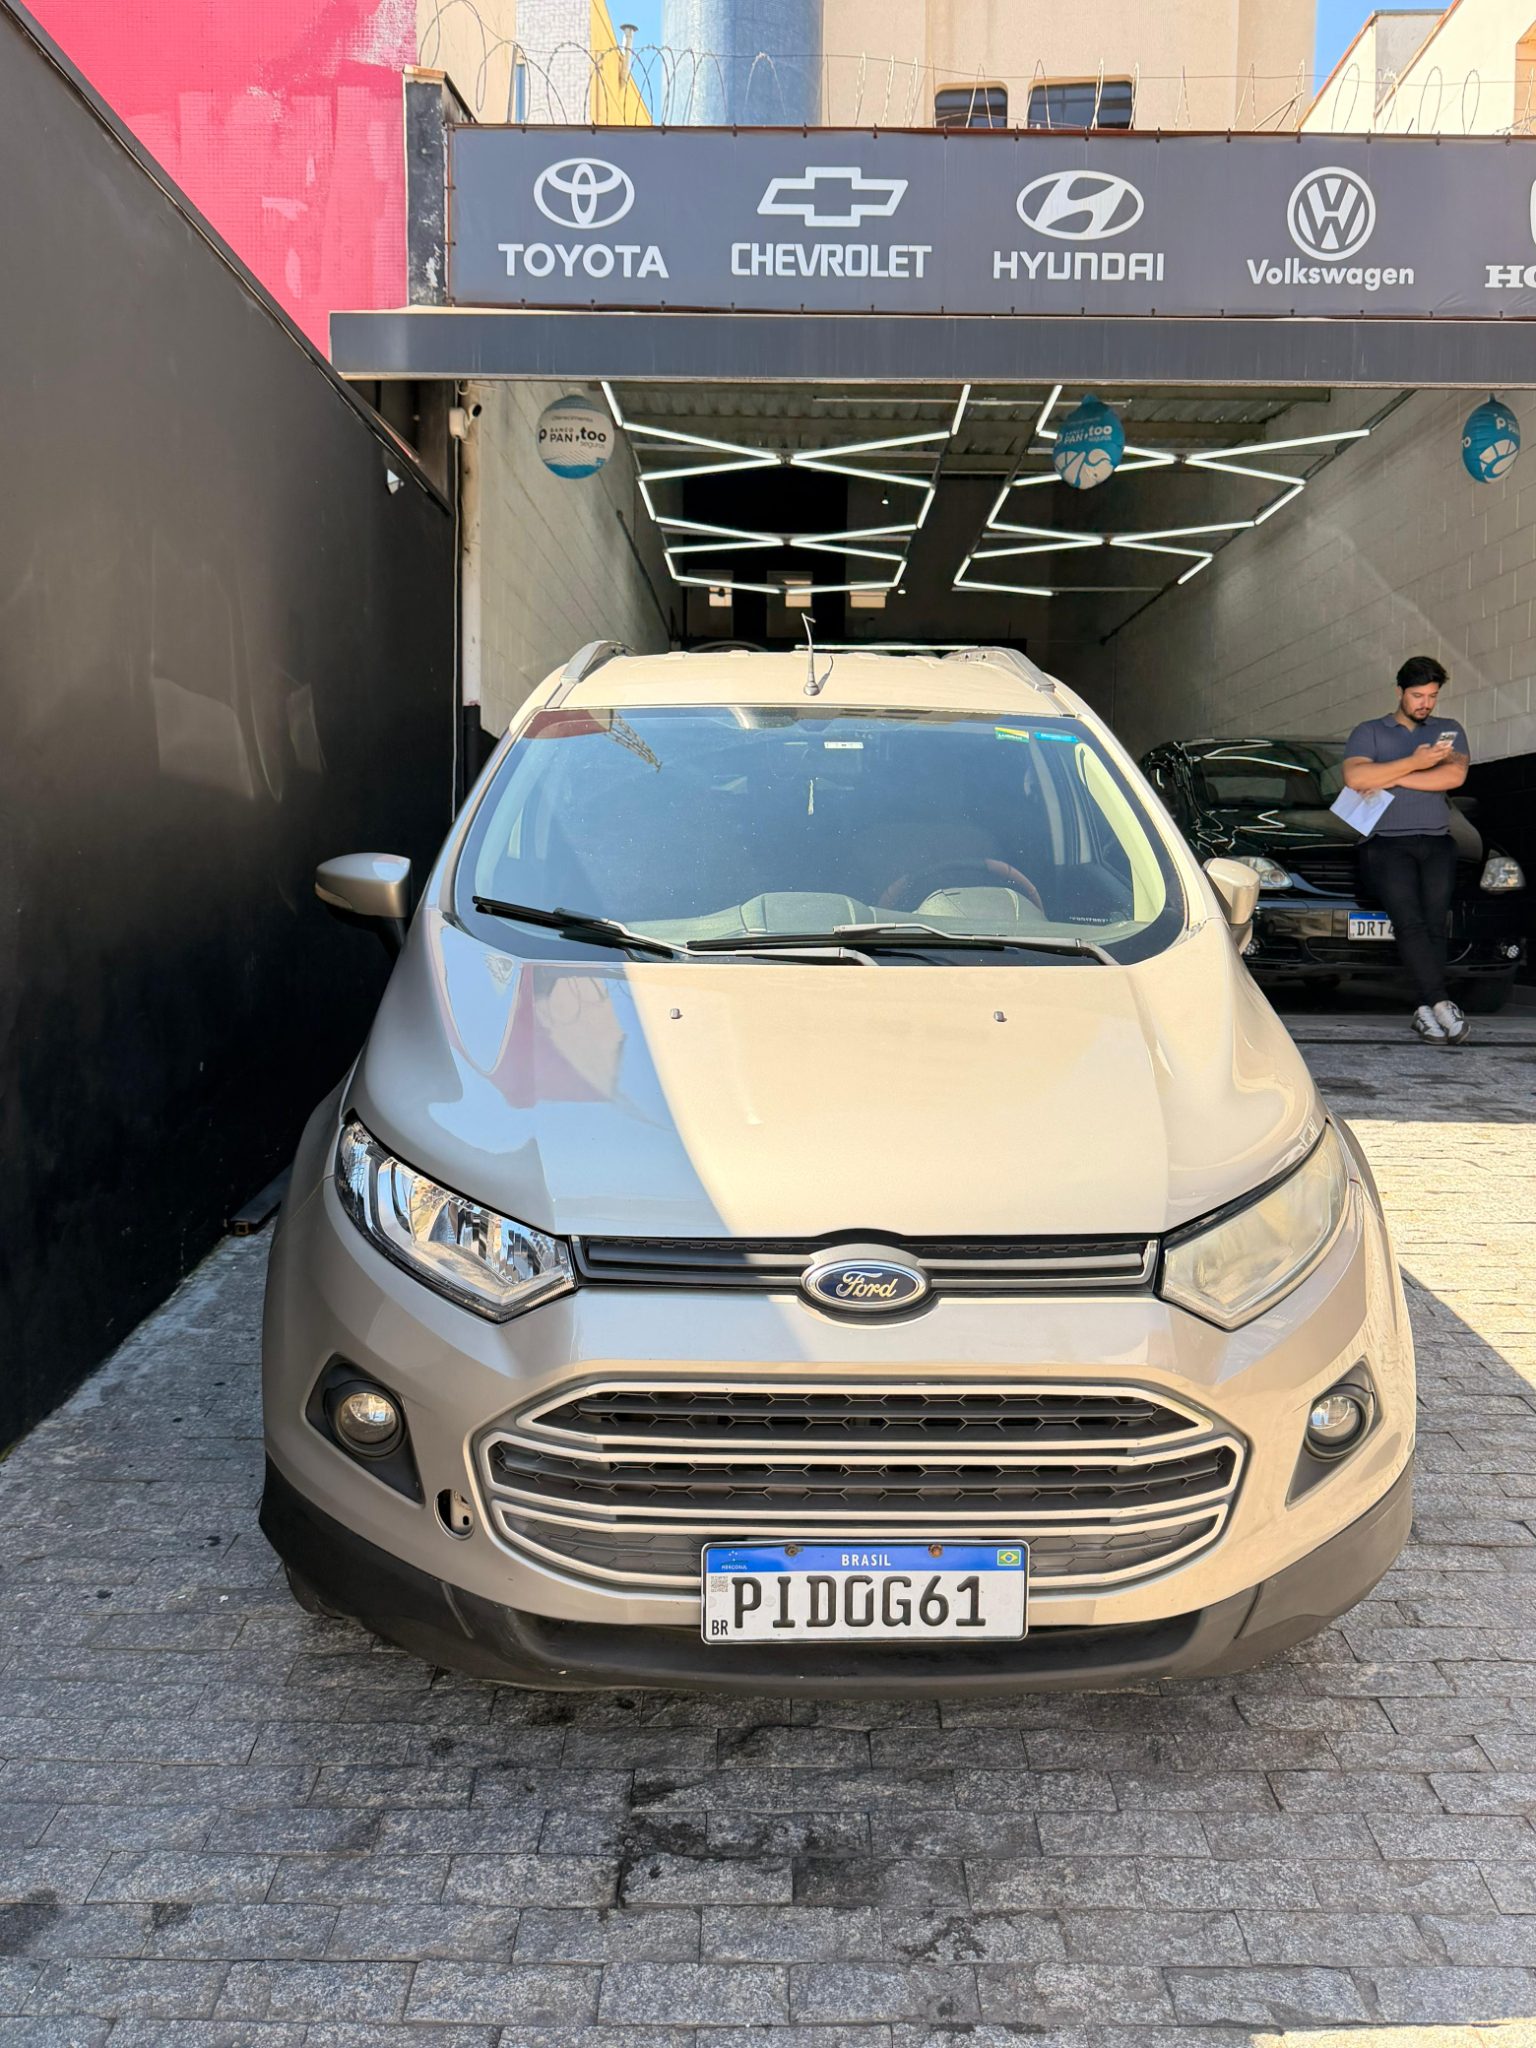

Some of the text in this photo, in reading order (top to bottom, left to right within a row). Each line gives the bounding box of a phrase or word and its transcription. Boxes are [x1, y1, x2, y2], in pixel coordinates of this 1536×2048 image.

[498, 243, 670, 280] TOYOTA
[731, 243, 932, 279] CHEVROLET
[993, 251, 1165, 282] HYUNDAI
[1247, 257, 1415, 292] Volkswagen
[550, 433, 574, 443] PAN
[835, 1270, 899, 1298] Ford
[841, 1553, 892, 1567] BRASIL
[711, 1619, 729, 1636] BR
